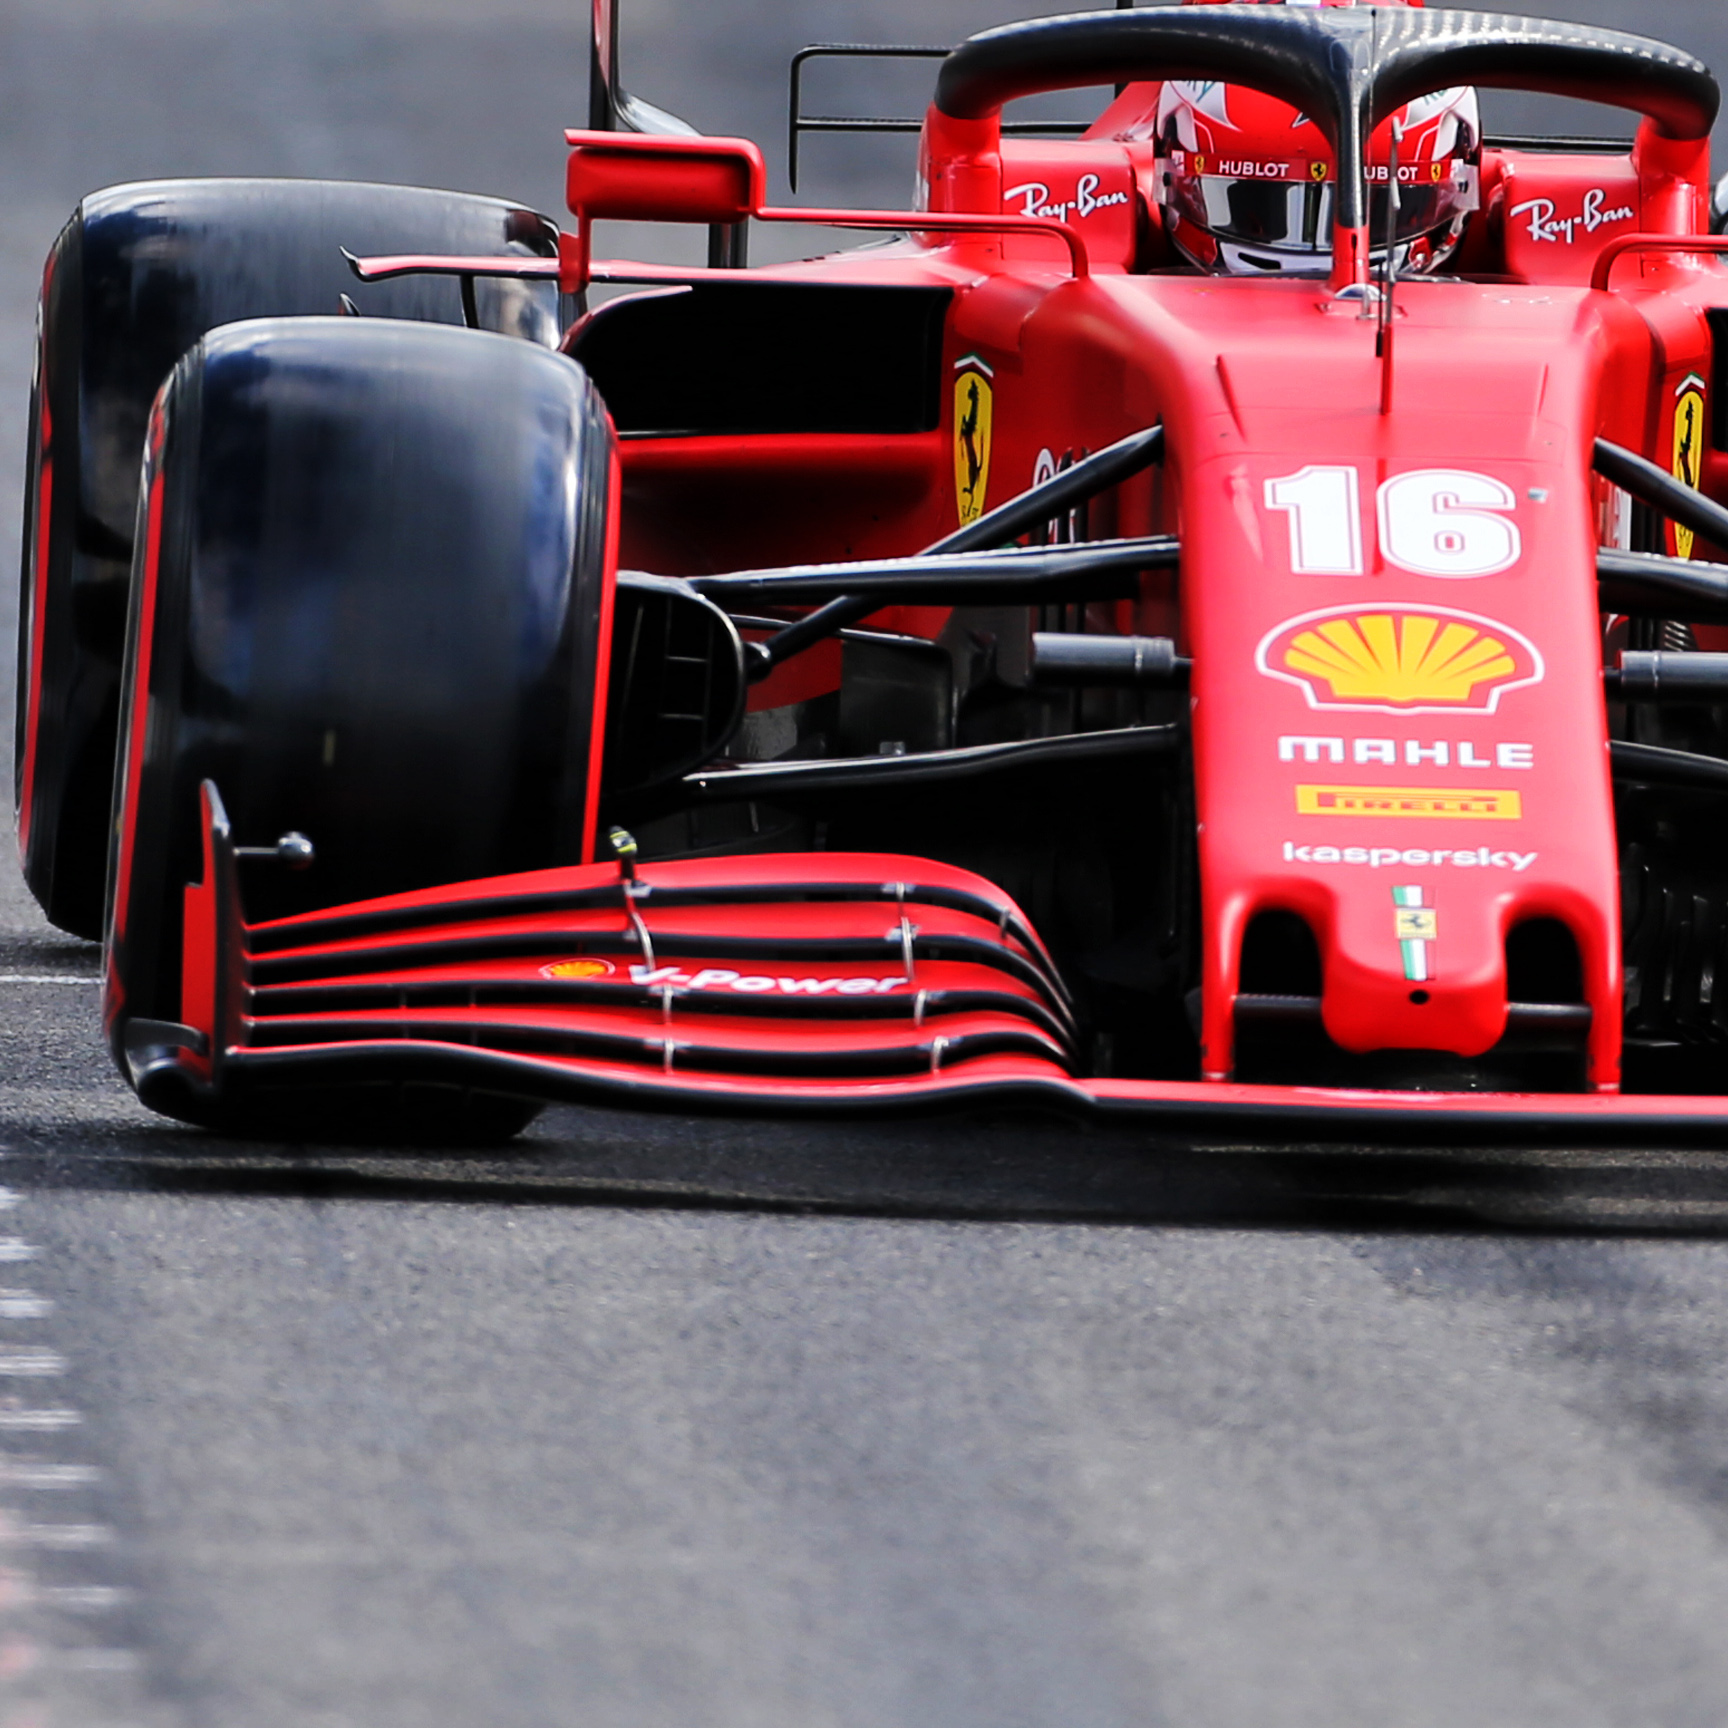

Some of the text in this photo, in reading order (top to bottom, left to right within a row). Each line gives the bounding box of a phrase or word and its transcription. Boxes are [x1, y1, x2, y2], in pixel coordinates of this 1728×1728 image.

[1218, 159, 1290, 178] HUBLOT
[1363, 165, 1419, 181] UBOT
[1003, 173, 1129, 223] Ray-Ban
[1510, 188, 1634, 244] Ray-Ban
[1263, 465, 1522, 579] 16
[1278, 735, 1534, 769] MAHLE
[1316, 791, 1499, 813] PIRELLI
[1283, 841, 1539, 871] kaspersky
[628, 964, 910, 994] V-Power
